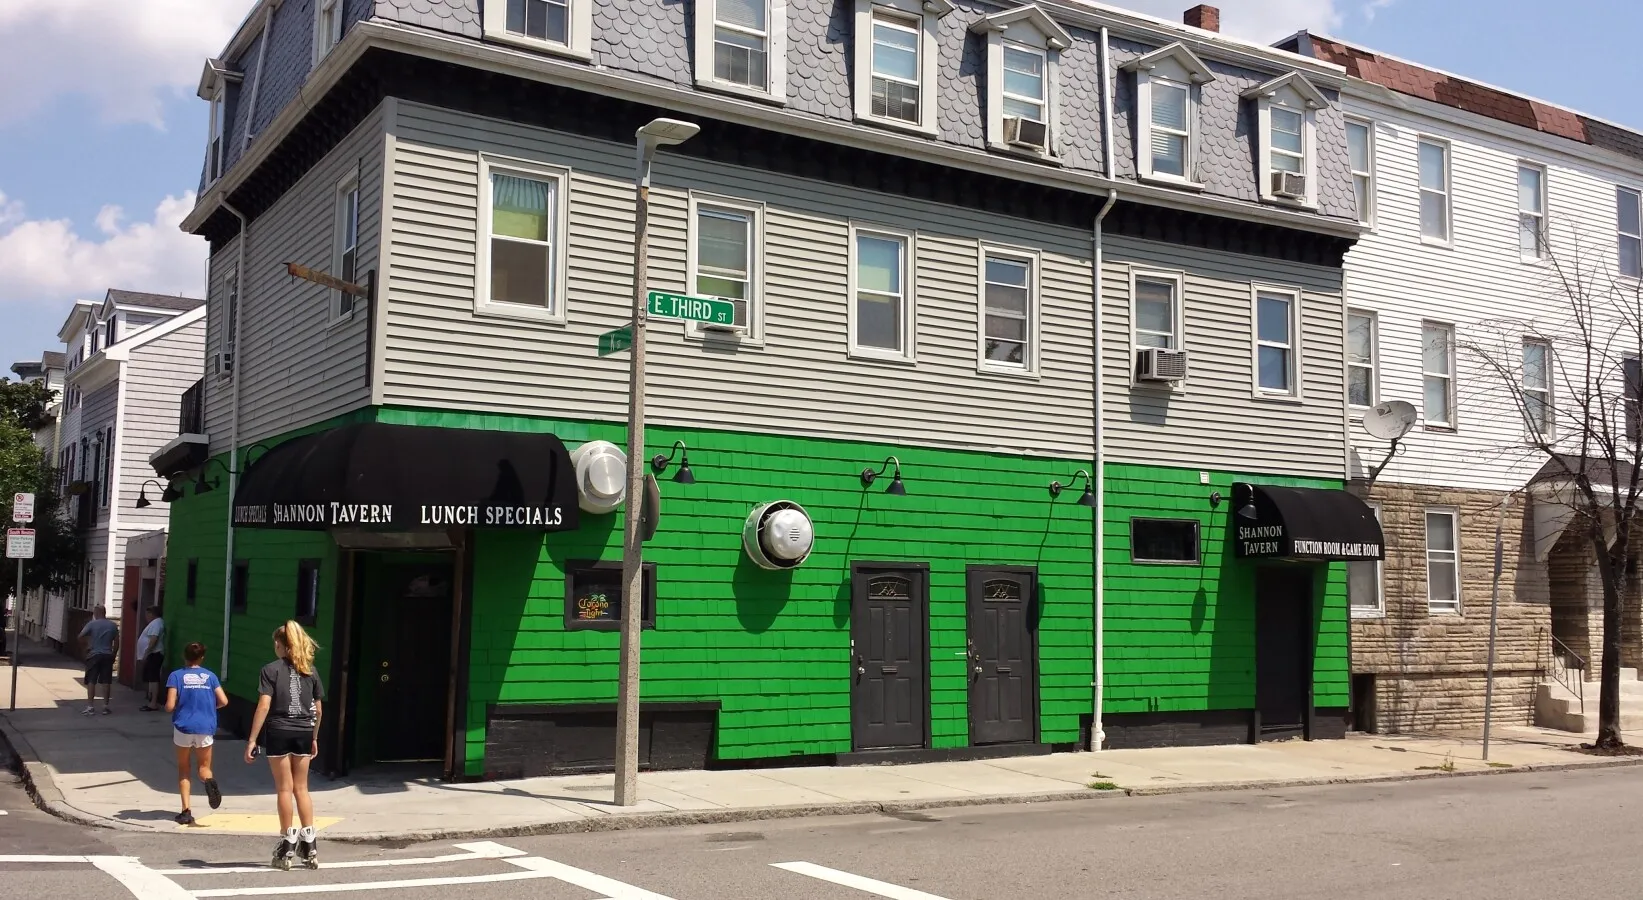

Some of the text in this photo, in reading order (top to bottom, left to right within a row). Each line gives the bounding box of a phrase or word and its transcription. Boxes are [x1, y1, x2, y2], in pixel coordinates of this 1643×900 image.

[655, 295, 727, 322] E. THIRD ST
[610, 333, 616, 351] K
[235, 506, 267, 523] LUNCH SPECIALS
[273, 501, 393, 525] SHANNON TAVERN
[421, 505, 563, 526] LUNCH SPECIALS
[1239, 525, 1283, 540] SHANNON
[1243, 541, 1278, 556] TAVERN
[1294, 540, 1323, 554] FUNCTION
[1323, 541, 1340, 555] ROOM
[1362, 543, 1380, 557] ROOM
